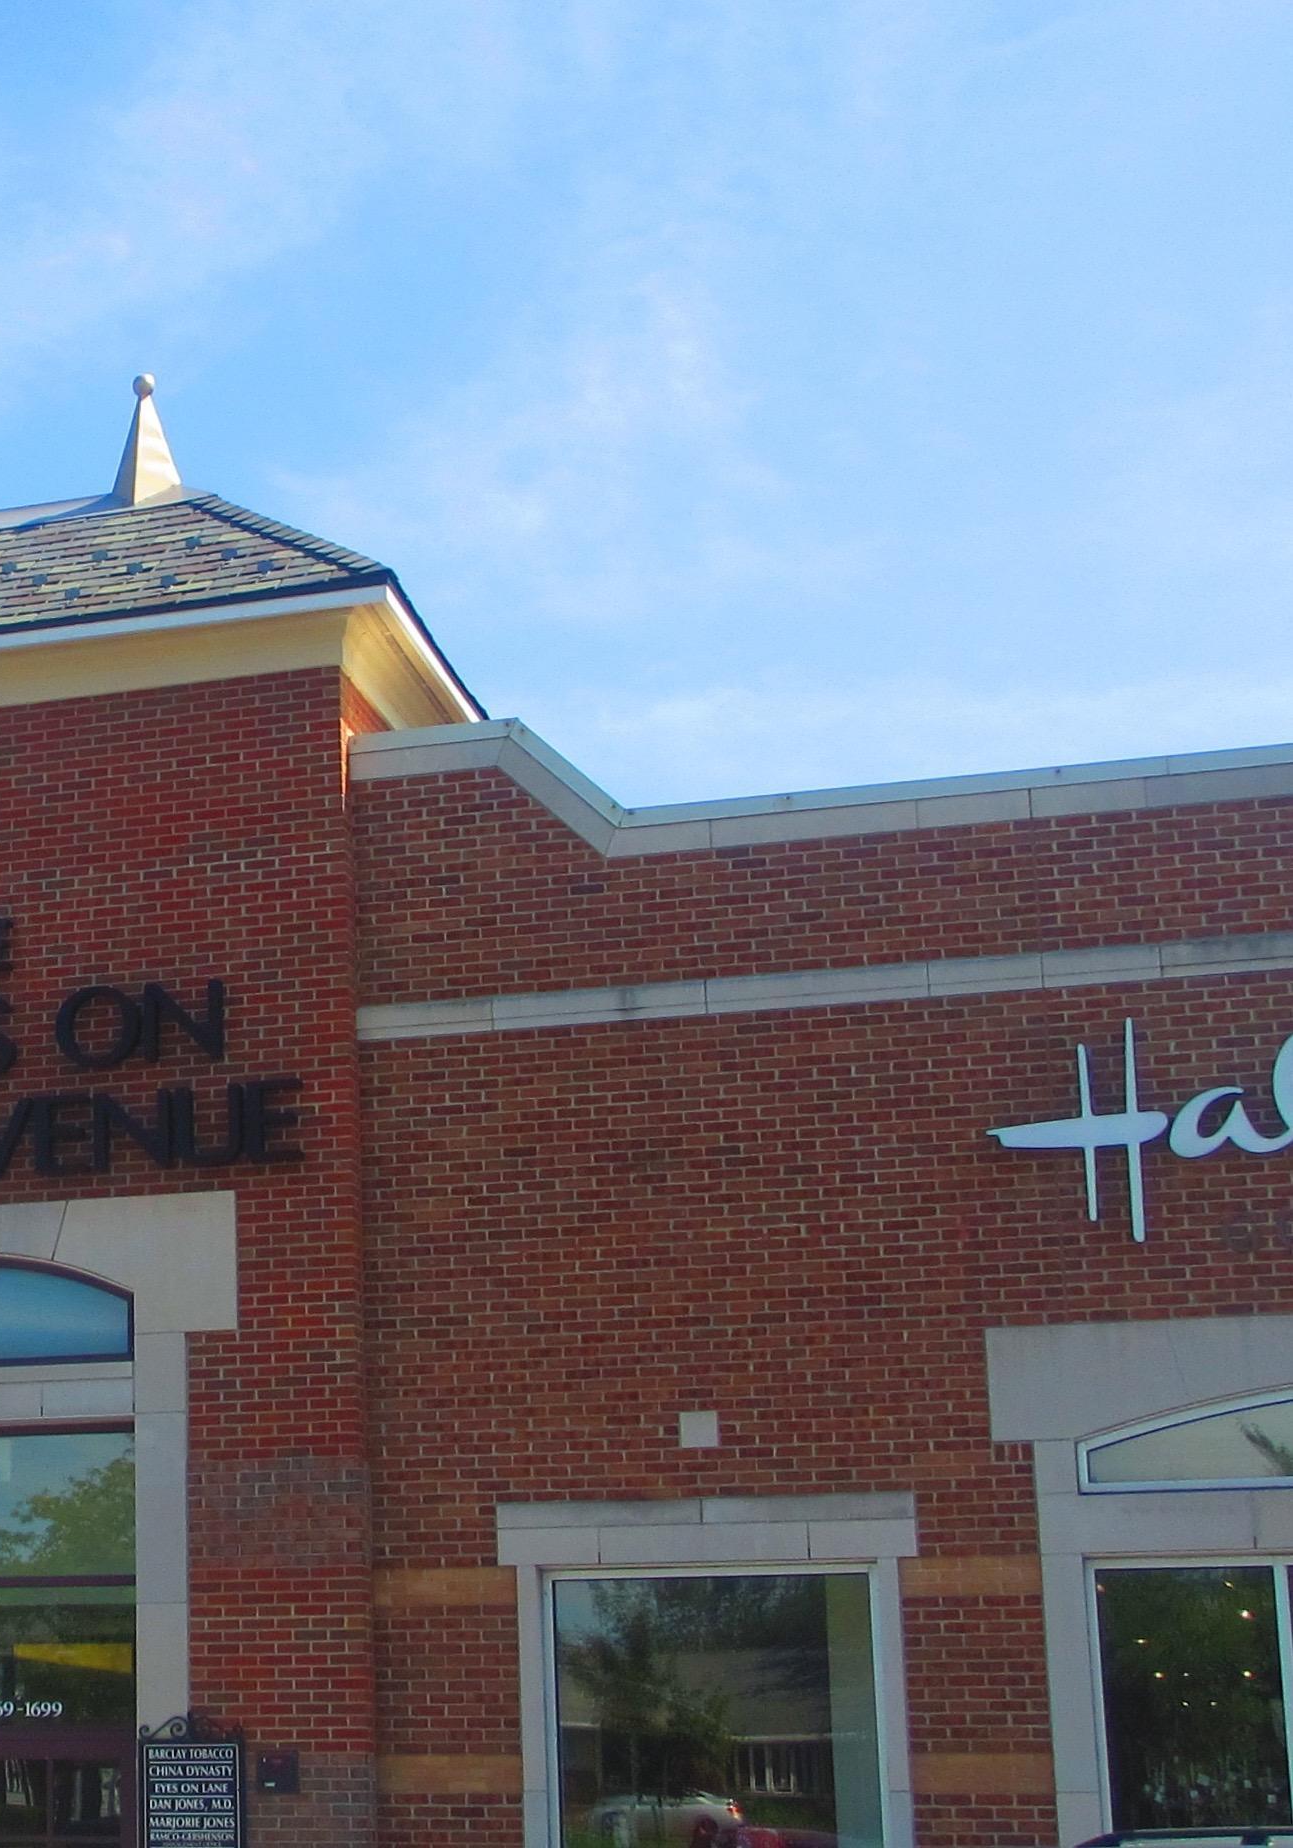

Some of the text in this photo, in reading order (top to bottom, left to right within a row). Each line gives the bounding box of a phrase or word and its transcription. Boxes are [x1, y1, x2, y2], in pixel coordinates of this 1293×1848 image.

[55, 978, 225, 1070] ON
[148, 1747, 234, 1760] BARCLAY TOBACCO
[149, 1765, 234, 1777] CHINA DYNASTY
[154, 1782, 229, 1793] EYES ON LANE
[149, 1799, 235, 1811] DAN JONES, M.D.
[149, 1817, 235, 1829] MARJORIE JONES
